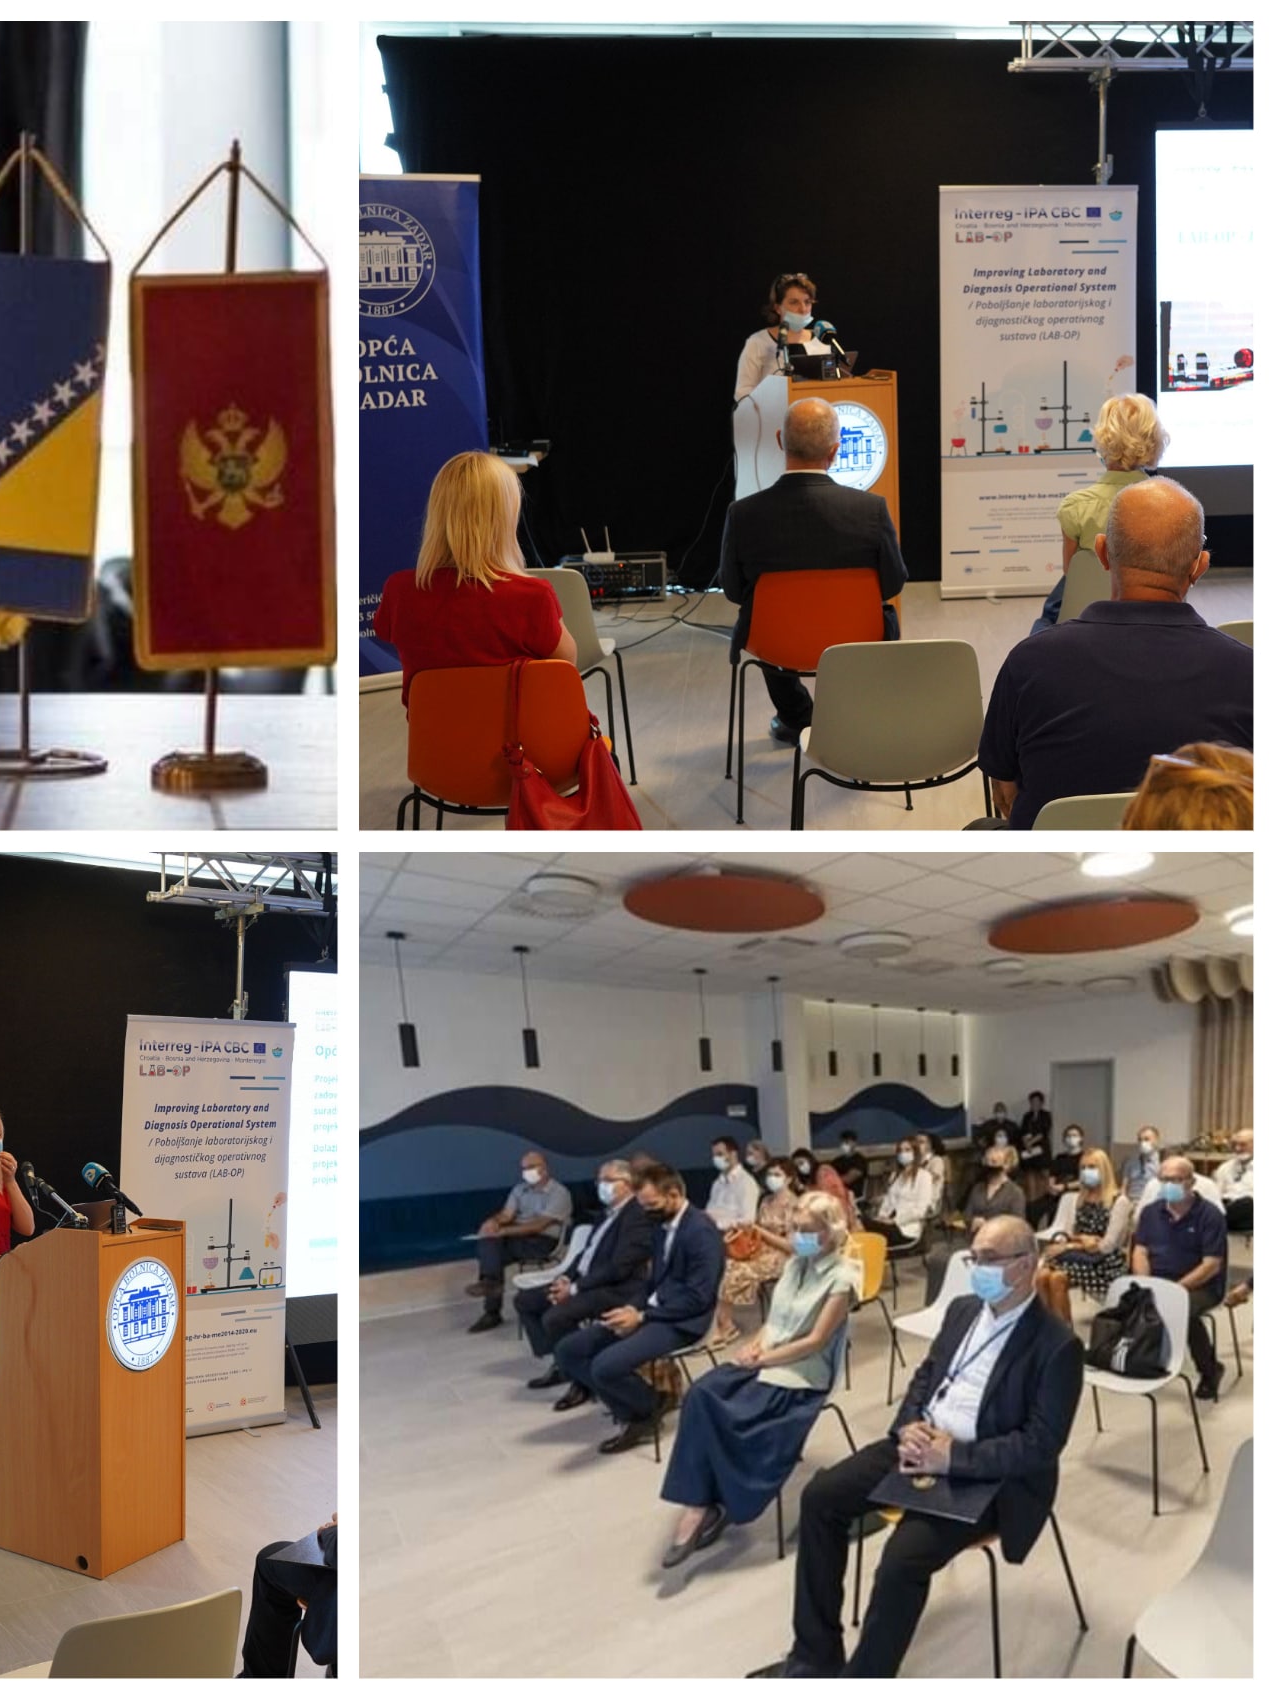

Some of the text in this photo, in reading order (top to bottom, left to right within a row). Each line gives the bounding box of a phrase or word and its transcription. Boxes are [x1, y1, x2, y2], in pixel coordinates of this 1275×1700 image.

[1024, 207, 1048, 219] IPA
[1051, 207, 1081, 218] CBC
[403, 216, 433, 261] ZADAR
[973, 266, 1107, 279] Improving Laboratory and
[963, 282, 1117, 296] Diagnosis Operational System
[367, 304, 396, 315] 1887
[975, 299, 1030, 312] Poboljšanje
[1033, 298, 1106, 310] laboratorijskog
[975, 315, 1105, 328] dijagnostičkog operativnog
[1000, 331, 1081, 342] sustava (LAB-OP)
[359, 362, 438, 384] LNICA
[200, 1040, 222, 1053] IPA
[224, 1041, 250, 1054] CBC
[154, 1103, 270, 1115] Improving Laboratory and
[144, 1119, 277, 1132] Diagnosis Operational System
[155, 1137, 203, 1150] Poboljšanje
[205, 1136, 268, 1149] laboratorijskog
[154, 1152, 267, 1166] dijagnostičkog operativnog
[175, 1168, 245, 1180] sustava (LAB-OP)
